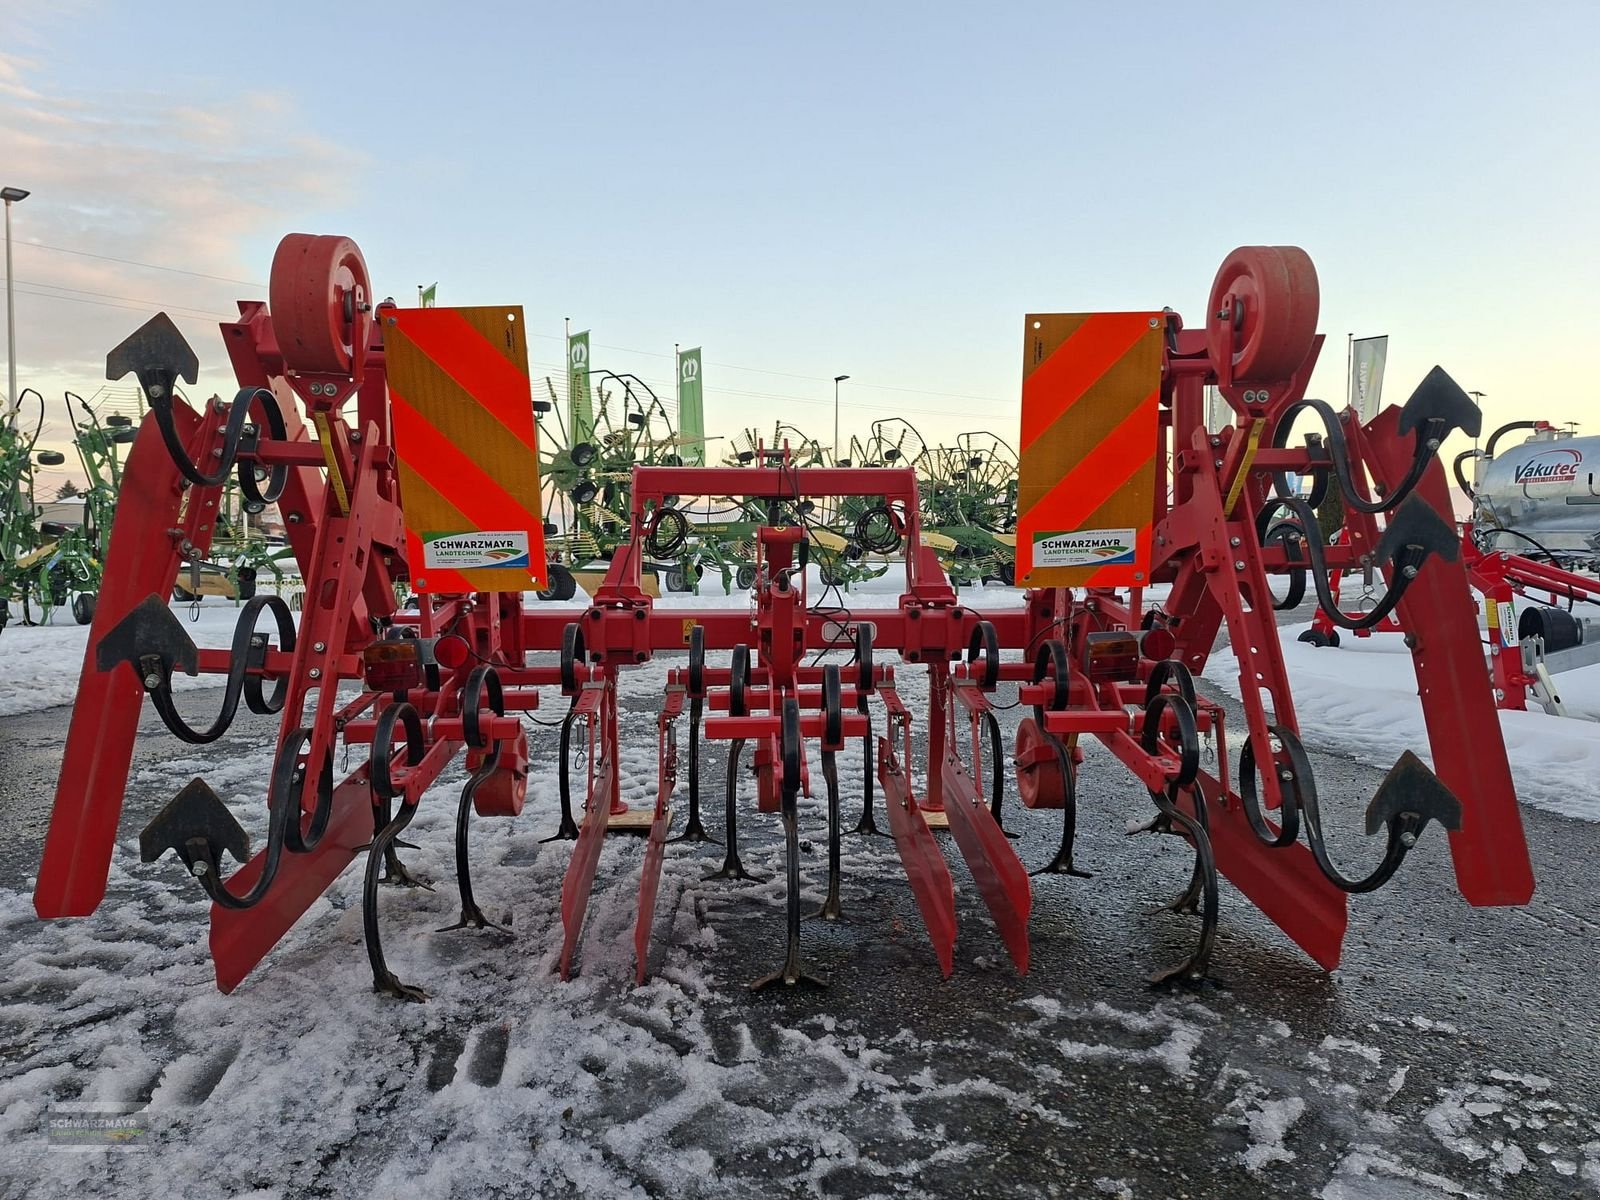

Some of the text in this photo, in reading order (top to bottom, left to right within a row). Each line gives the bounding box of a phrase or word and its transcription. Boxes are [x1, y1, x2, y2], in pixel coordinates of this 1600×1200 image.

[1514, 460, 1580, 484] Vakutec
[433, 540, 514, 549] SCHWARZMAYR
[1041, 538, 1121, 549] SCHWARZMAYR
